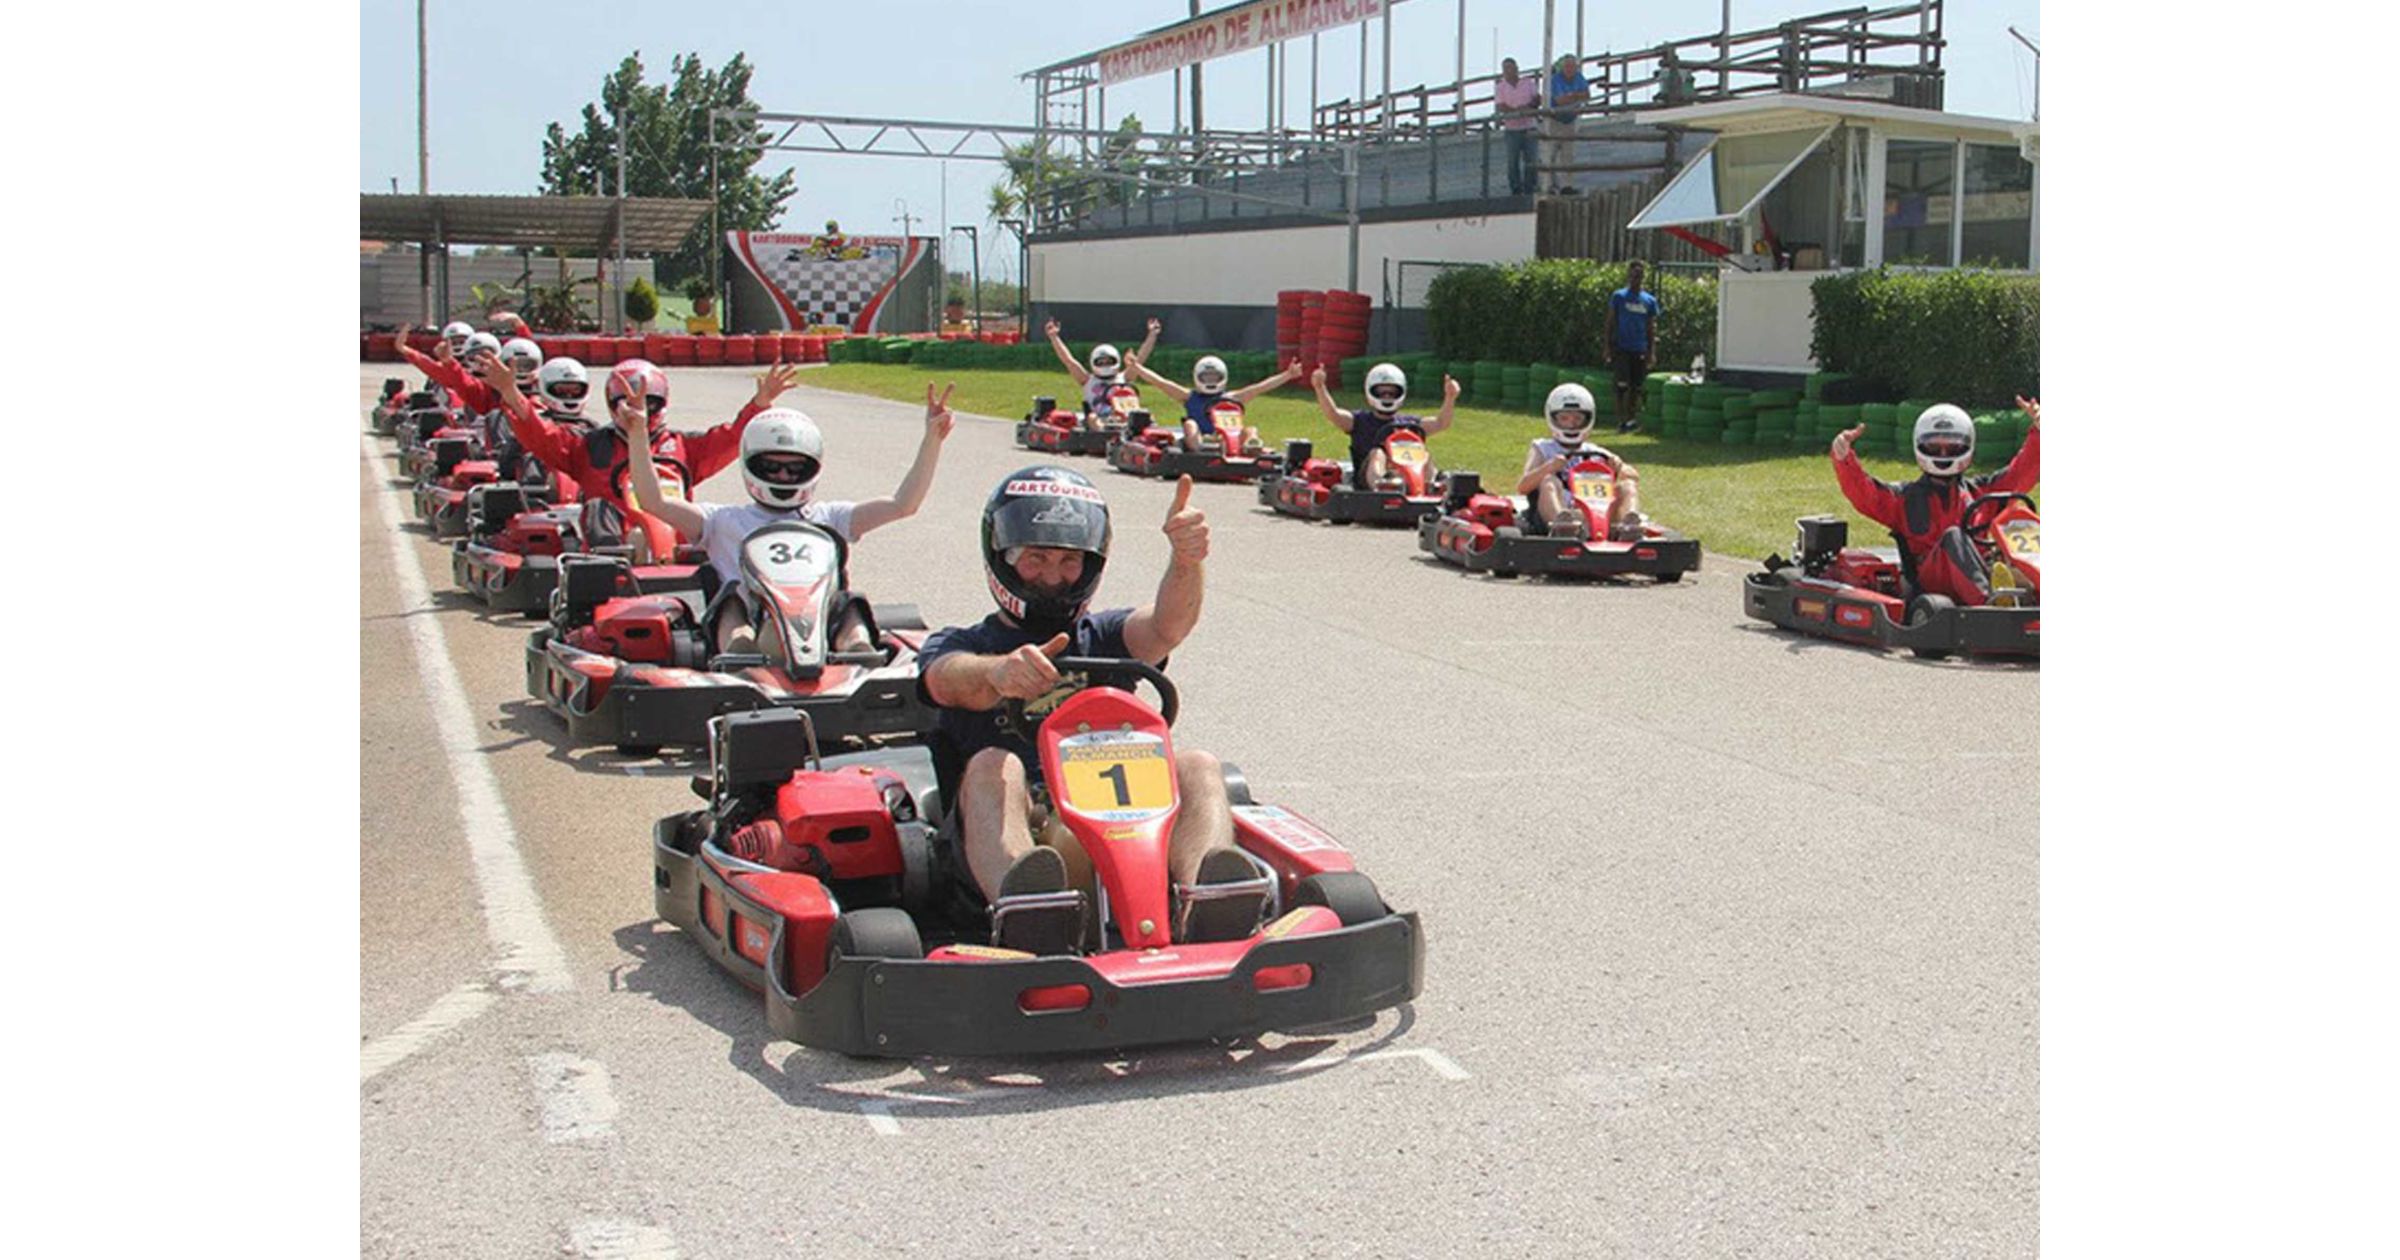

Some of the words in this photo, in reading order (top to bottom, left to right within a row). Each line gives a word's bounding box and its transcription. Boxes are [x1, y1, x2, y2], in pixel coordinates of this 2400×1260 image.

[1102, 24, 1217, 86] KARTODROMO
[1224, 16, 1251, 50] DE
[769, 542, 814, 565] 34
[1098, 763, 1132, 807] 1
